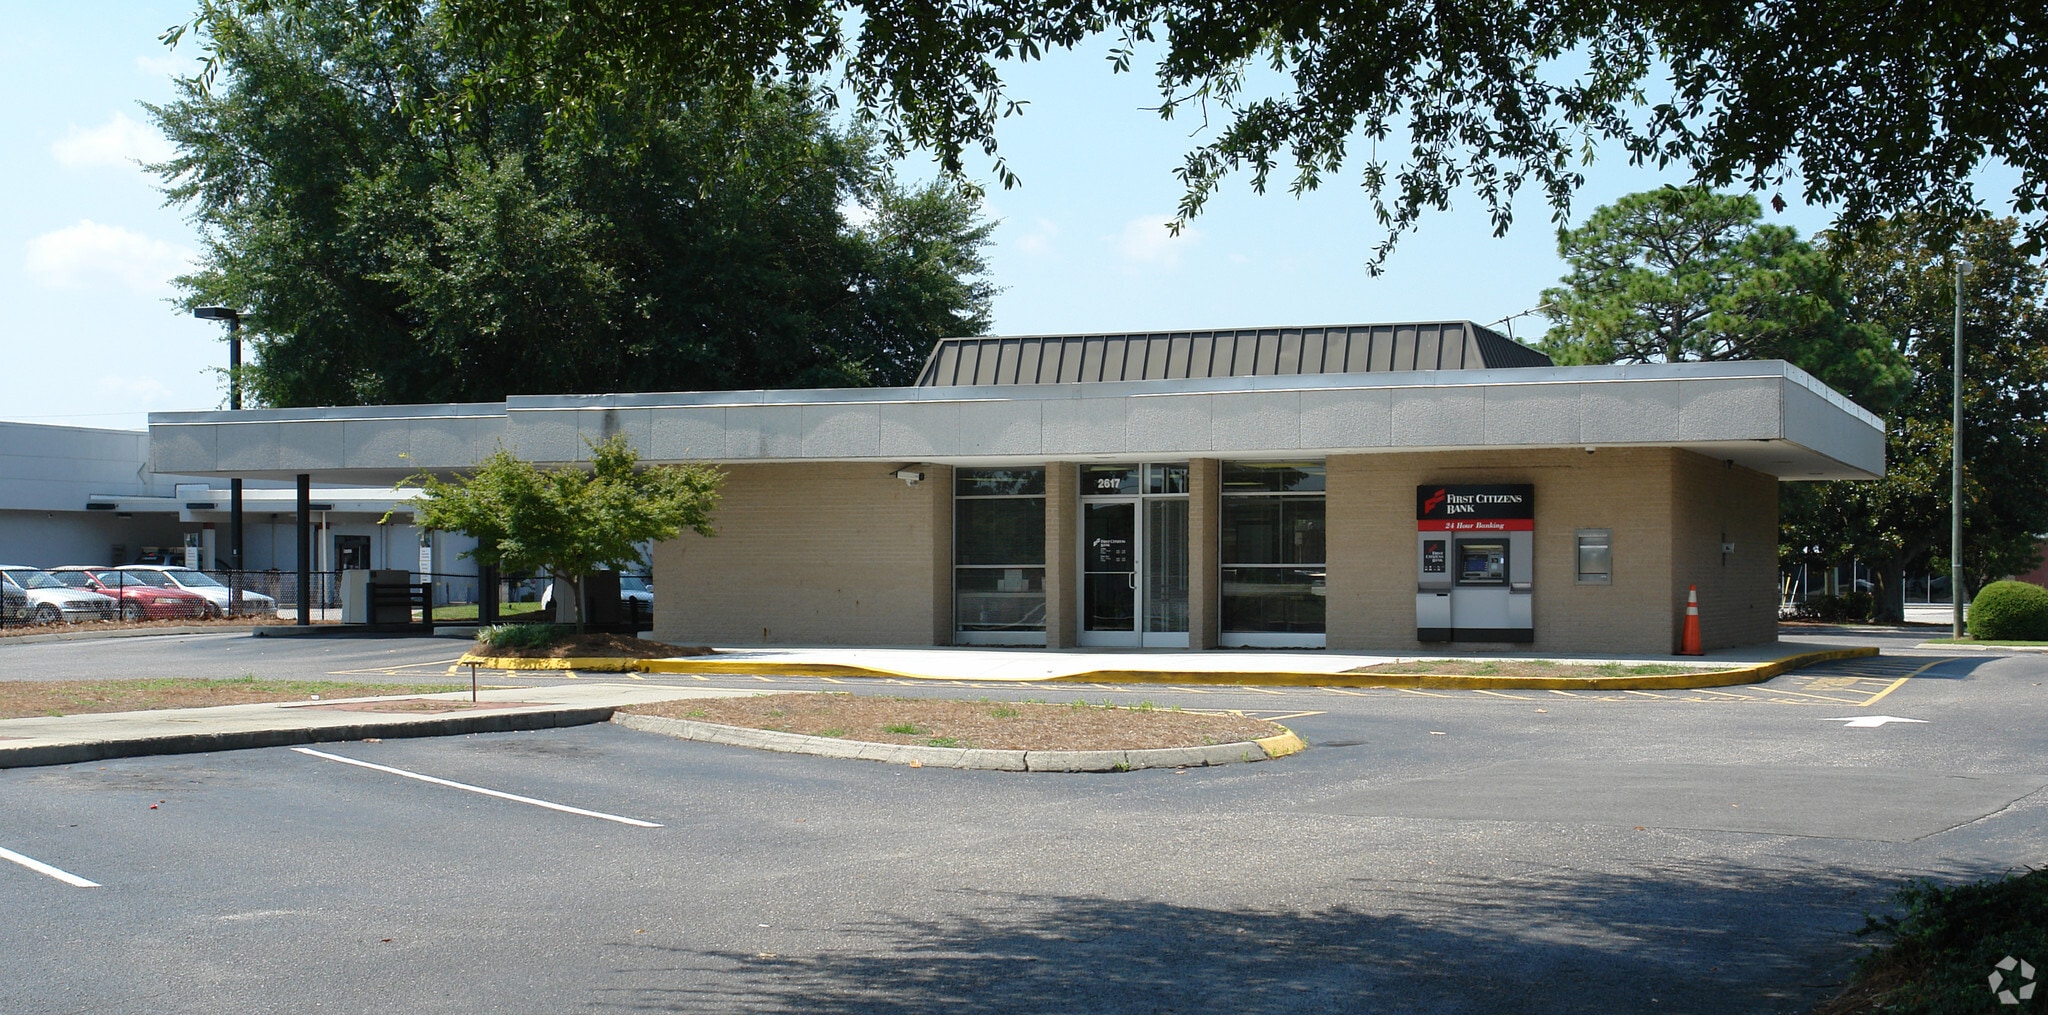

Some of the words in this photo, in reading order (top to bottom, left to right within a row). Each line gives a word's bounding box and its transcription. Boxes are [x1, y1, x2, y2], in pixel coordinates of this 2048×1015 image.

[1098, 478, 1120, 489] 2617
[1447, 494, 1474, 504] FIRST
[1475, 494, 1522, 503] CITIZENS
[1447, 505, 1475, 514] BANK
[1476, 522, 1504, 530] Banking
